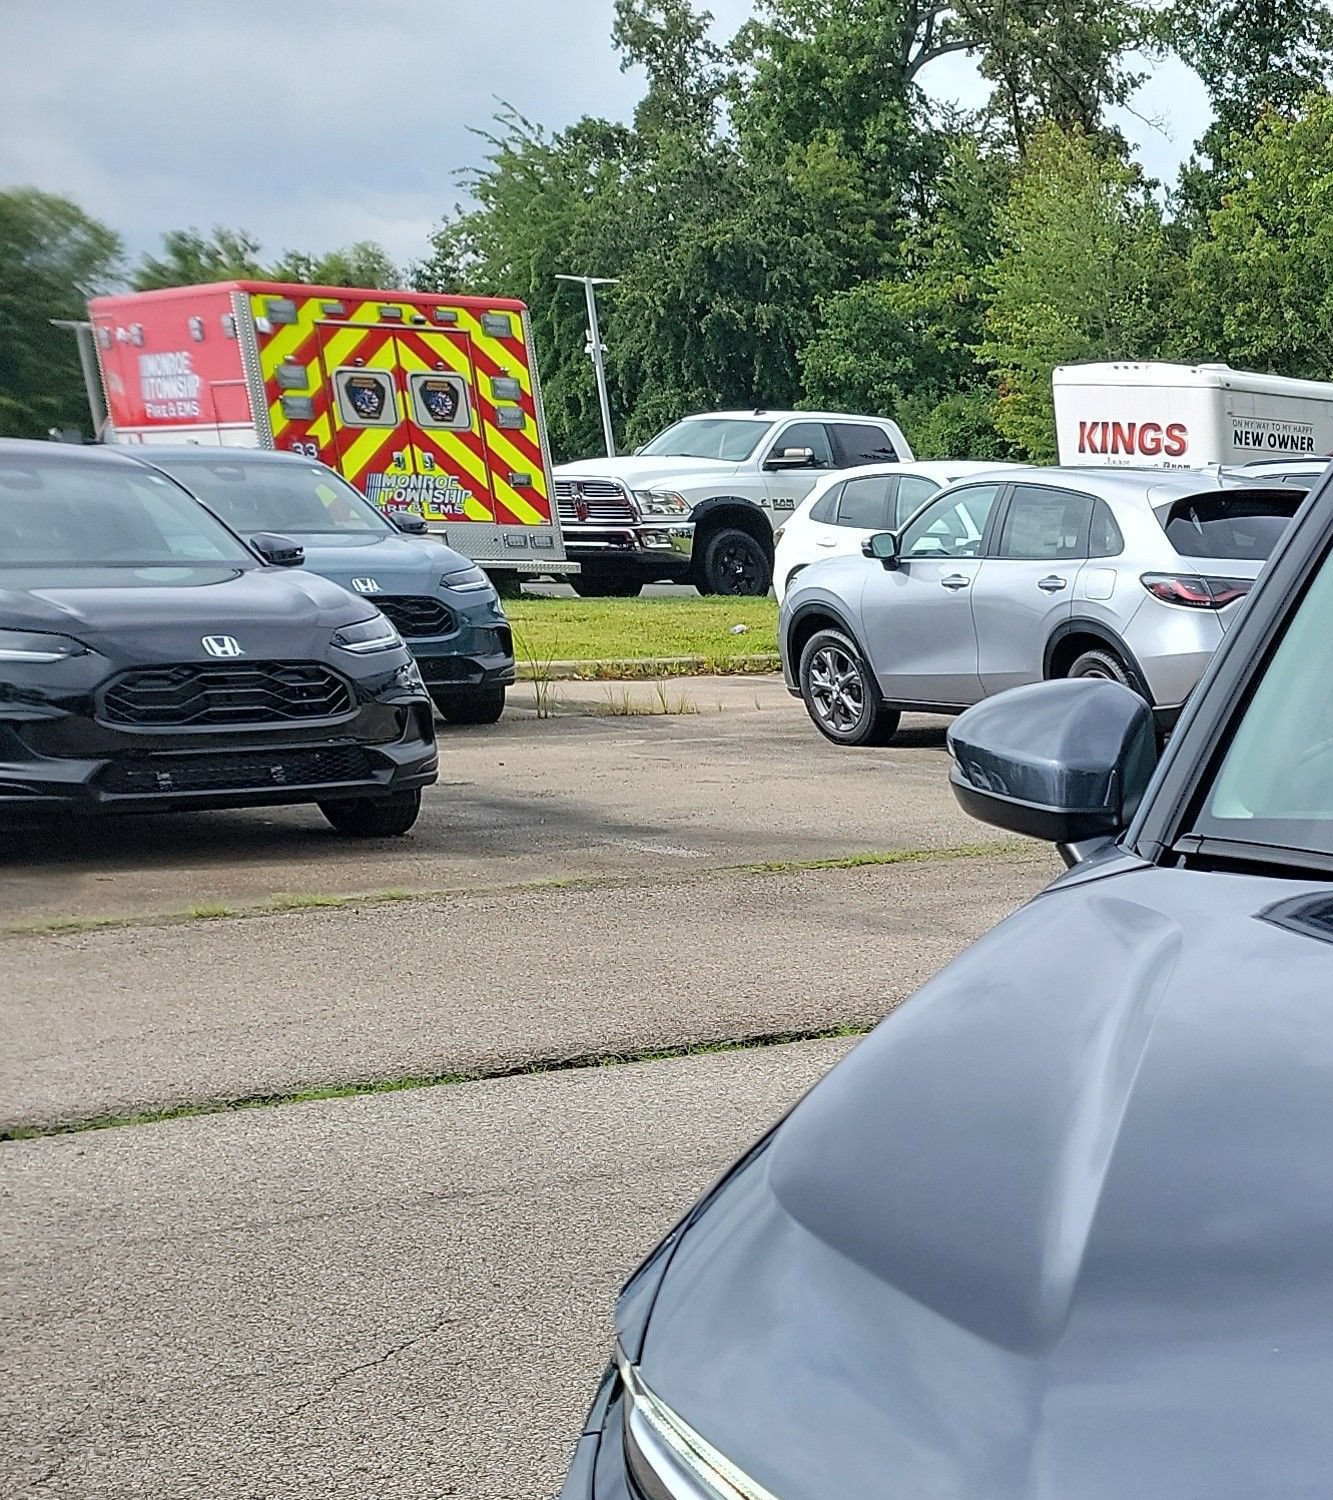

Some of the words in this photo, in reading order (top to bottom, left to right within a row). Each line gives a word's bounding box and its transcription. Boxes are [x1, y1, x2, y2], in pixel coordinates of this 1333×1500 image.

[1232, 419, 1243, 428] ON
[1255, 422, 1270, 430] WAY
[1272, 423, 1281, 431] TO
[1283, 424, 1292, 432] MY
[1294, 426, 1314, 434] HAPPY
[1078, 421, 1187, 457] KINGS
[1233, 429, 1264, 447] NEW
[1267, 433, 1314, 452] OWNER
[382, 474, 460, 489] MONROE
[379, 487, 473, 504] TOWNSHIP
[429, 503, 465, 514] EMS
